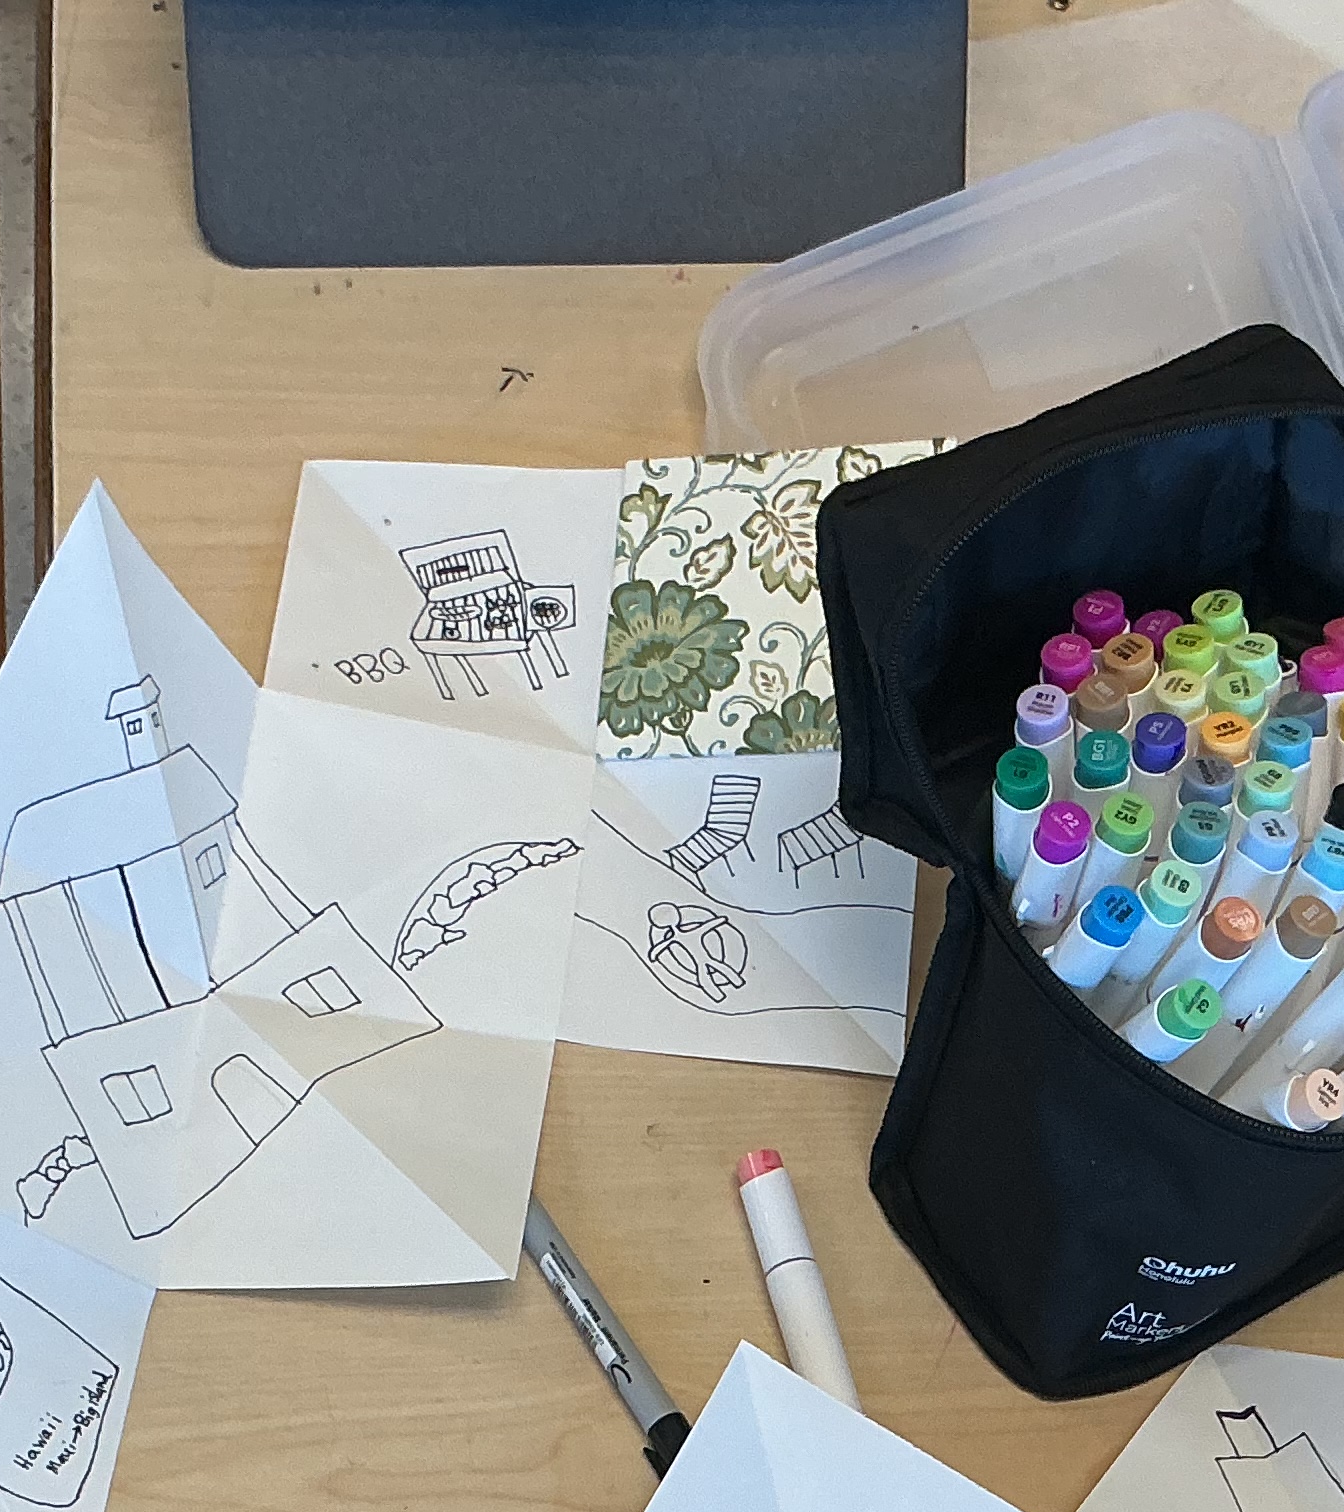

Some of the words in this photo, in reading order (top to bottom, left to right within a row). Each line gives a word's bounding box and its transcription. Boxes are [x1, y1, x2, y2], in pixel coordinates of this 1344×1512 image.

[333, 647, 412, 687] BBQ
[1062, 812, 1080, 829] P2
[1114, 809, 1139, 826] GY2
[1143, 1256, 1237, 1278] Ohuhu
[1111, 1302, 1167, 1329] Art
[13, 1411, 63, 1471] Hawaii
